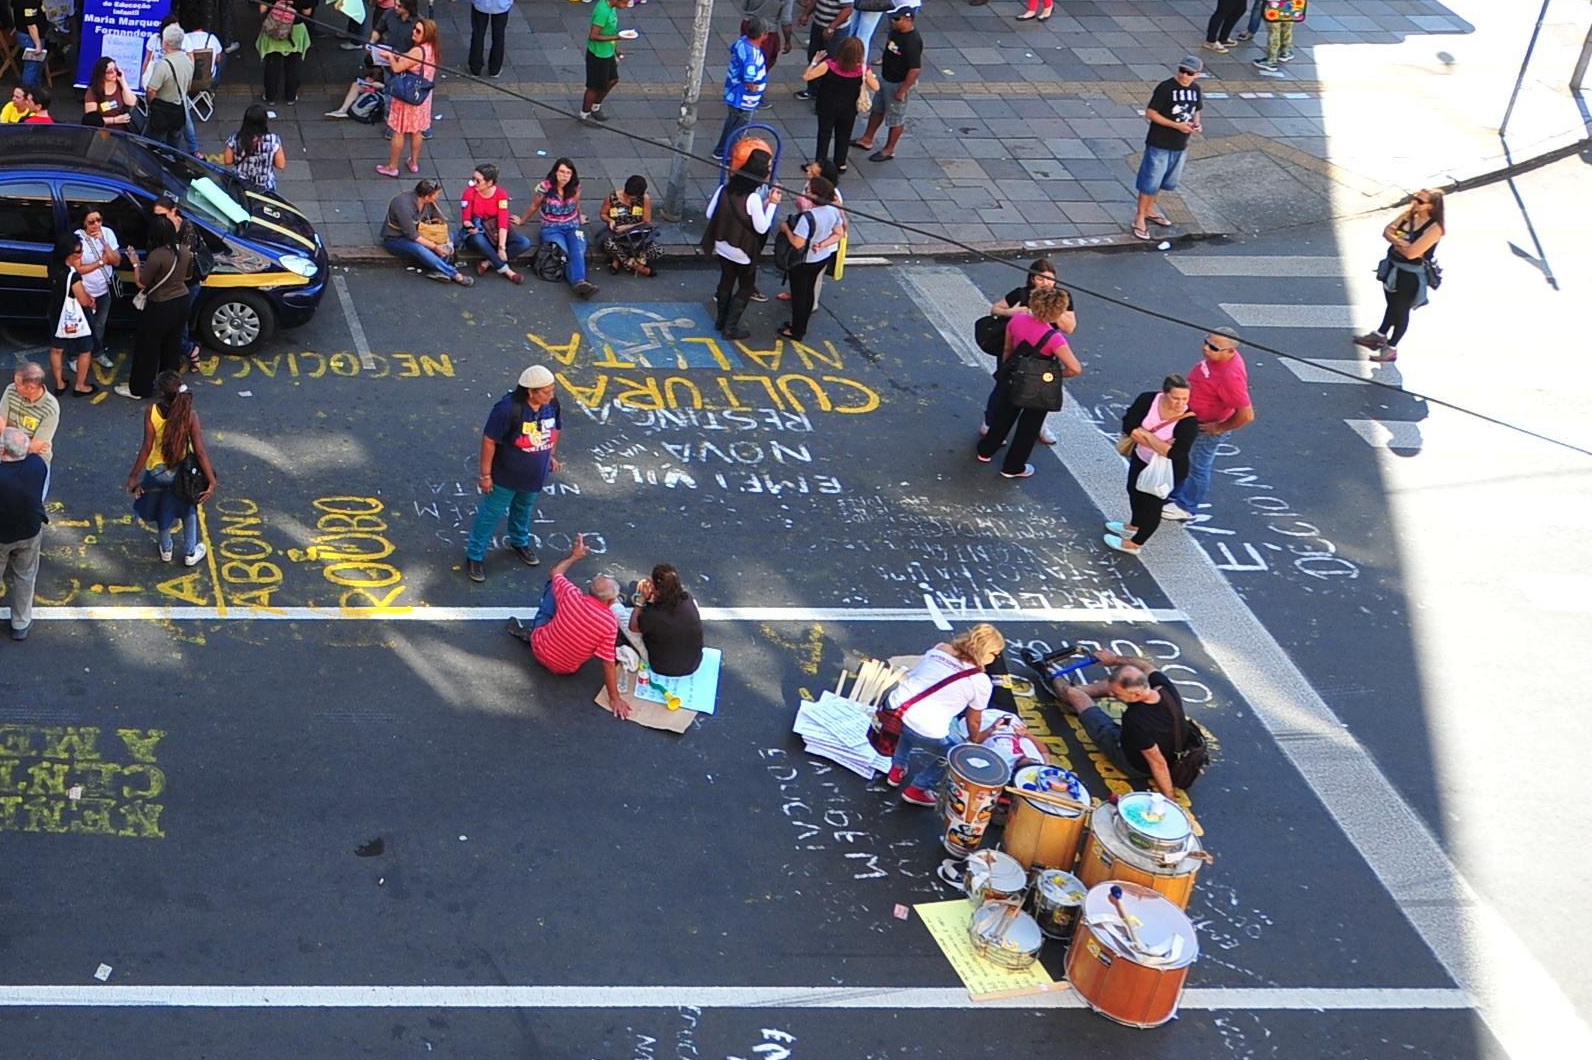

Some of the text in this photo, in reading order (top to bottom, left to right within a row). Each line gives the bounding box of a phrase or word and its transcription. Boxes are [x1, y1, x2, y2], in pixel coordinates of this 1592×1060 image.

[84, 14, 116, 25] Maria
[114, 1, 152, 10] Educação
[553, 371, 879, 415] CULTURA
[665, 440, 813, 465] NOVA
[310, 496, 414, 618] ROUBO
[115, 727, 168, 763] A
